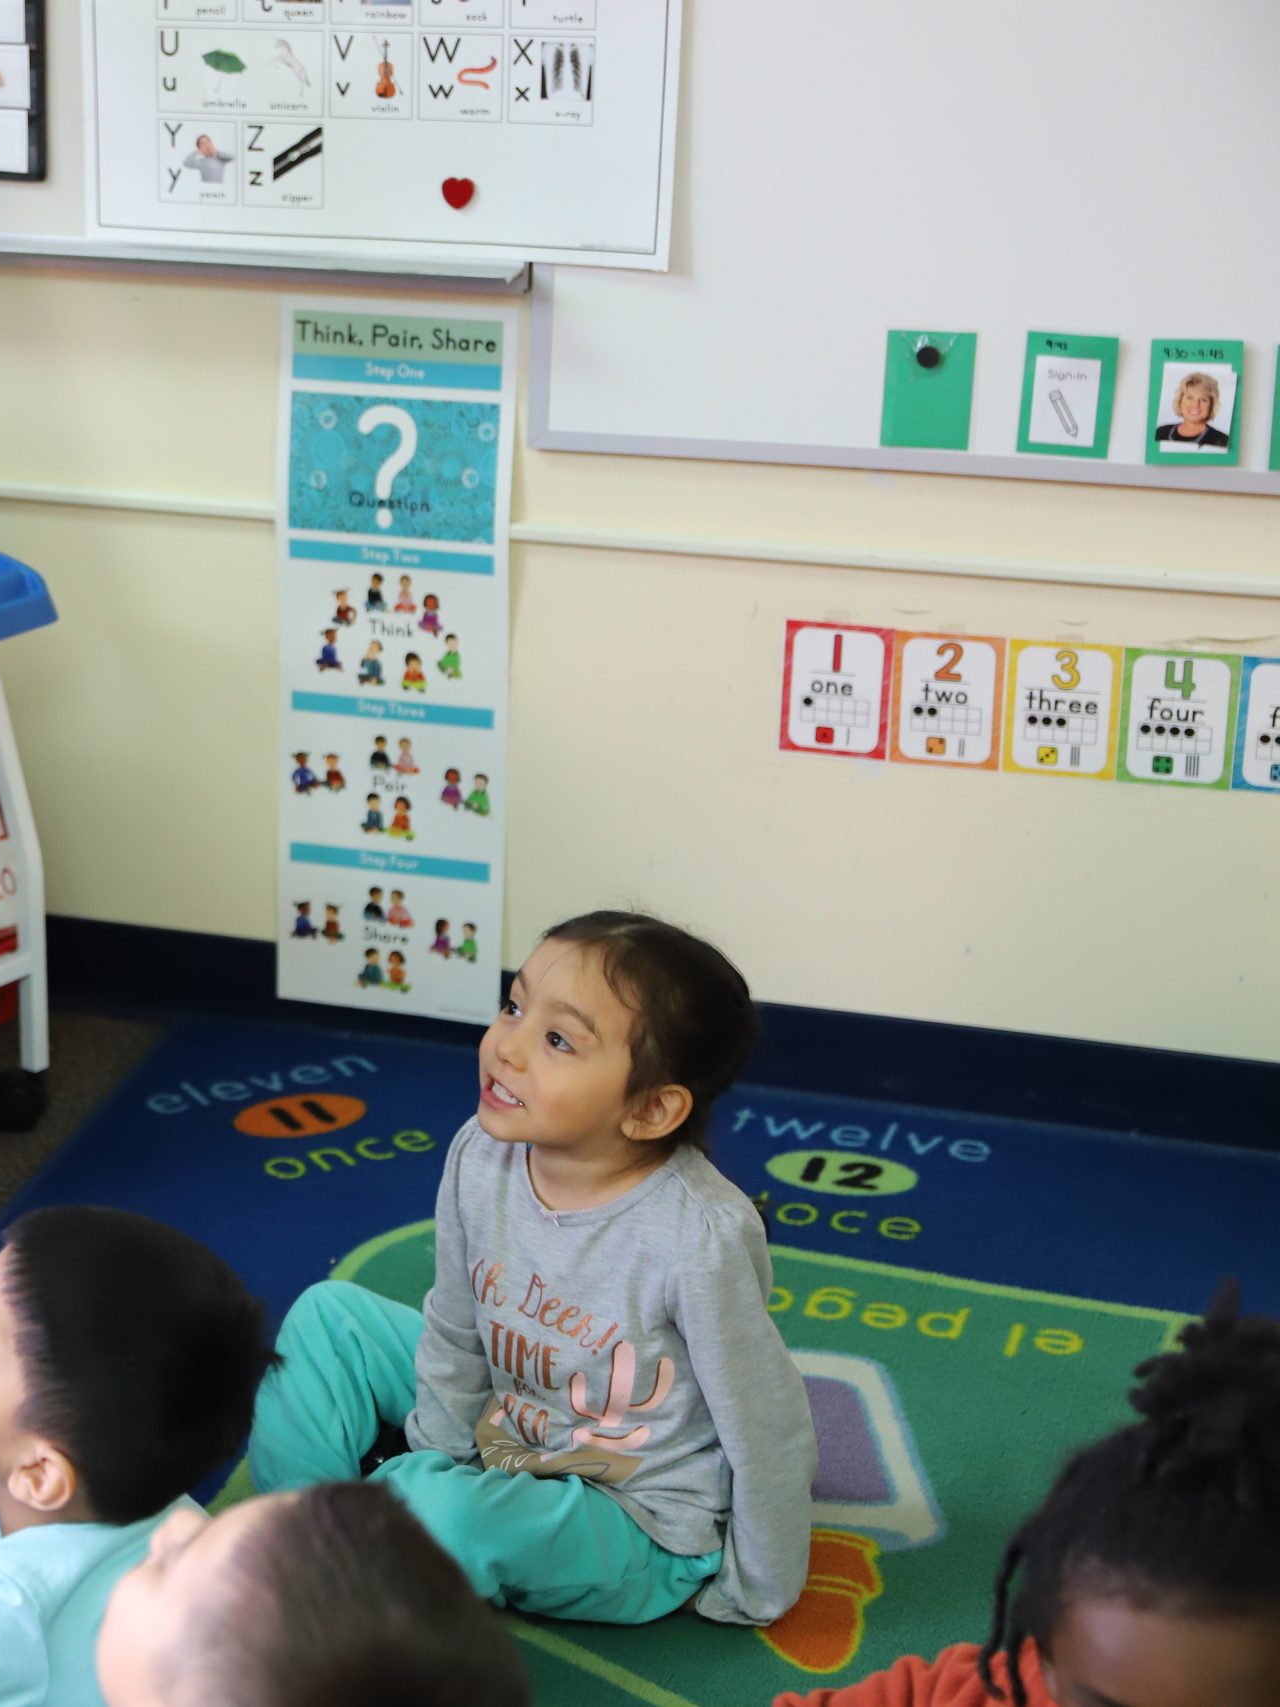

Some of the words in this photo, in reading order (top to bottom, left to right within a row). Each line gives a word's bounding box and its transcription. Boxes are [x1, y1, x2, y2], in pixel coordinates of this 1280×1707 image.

[552, 14, 584, 24] turtle
[160, 30, 180, 57] U
[333, 35, 354, 61] V
[423, 37, 461, 63] W
[513, 39, 534, 66] X
[163, 77, 177, 92] u
[336, 82, 350, 96] v
[428, 84, 454, 99] w
[515, 87, 530, 102] x
[164, 122, 182, 148] Y
[247, 125, 265, 151] Z
[168, 168, 182, 193] y
[249, 171, 263, 186] z
[431, 327, 497, 353] Share
[365, 361, 395, 381] Step
[396, 363, 425, 379] One
[1047, 369, 1088, 382] Sign-In
[348, 490, 431, 514] Question
[360, 546, 389, 565] Step
[391, 548, 421, 563] Two
[368, 618, 414, 638] Think
[832, 634, 843, 673] 1
[934, 642, 964, 682] 2
[1051, 650, 1081, 690] 3
[1165, 660, 1196, 700] 4
[810, 680, 853, 696] one
[922, 683, 968, 704] two
[357, 700, 386, 717] Step
[387, 703, 426, 718] Three
[1026, 689, 1098, 715] three
[1147, 698, 1205, 722] four
[372, 774, 408, 793] Pair
[359, 852, 386, 870] Step
[387, 856, 419, 869] Four
[361, 926, 409, 945] Share
[146, 1054, 378, 1115] eleven
[267, 1100, 338, 1131] 11
[730, 1107, 991, 1163] twelve
[264, 1129, 436, 1179] once
[799, 1156, 884, 1191] 12
[517, 1272, 621, 1356] Deer!
[1003, 1322, 1084, 1357] el
[489, 1319, 560, 1390] TIME
